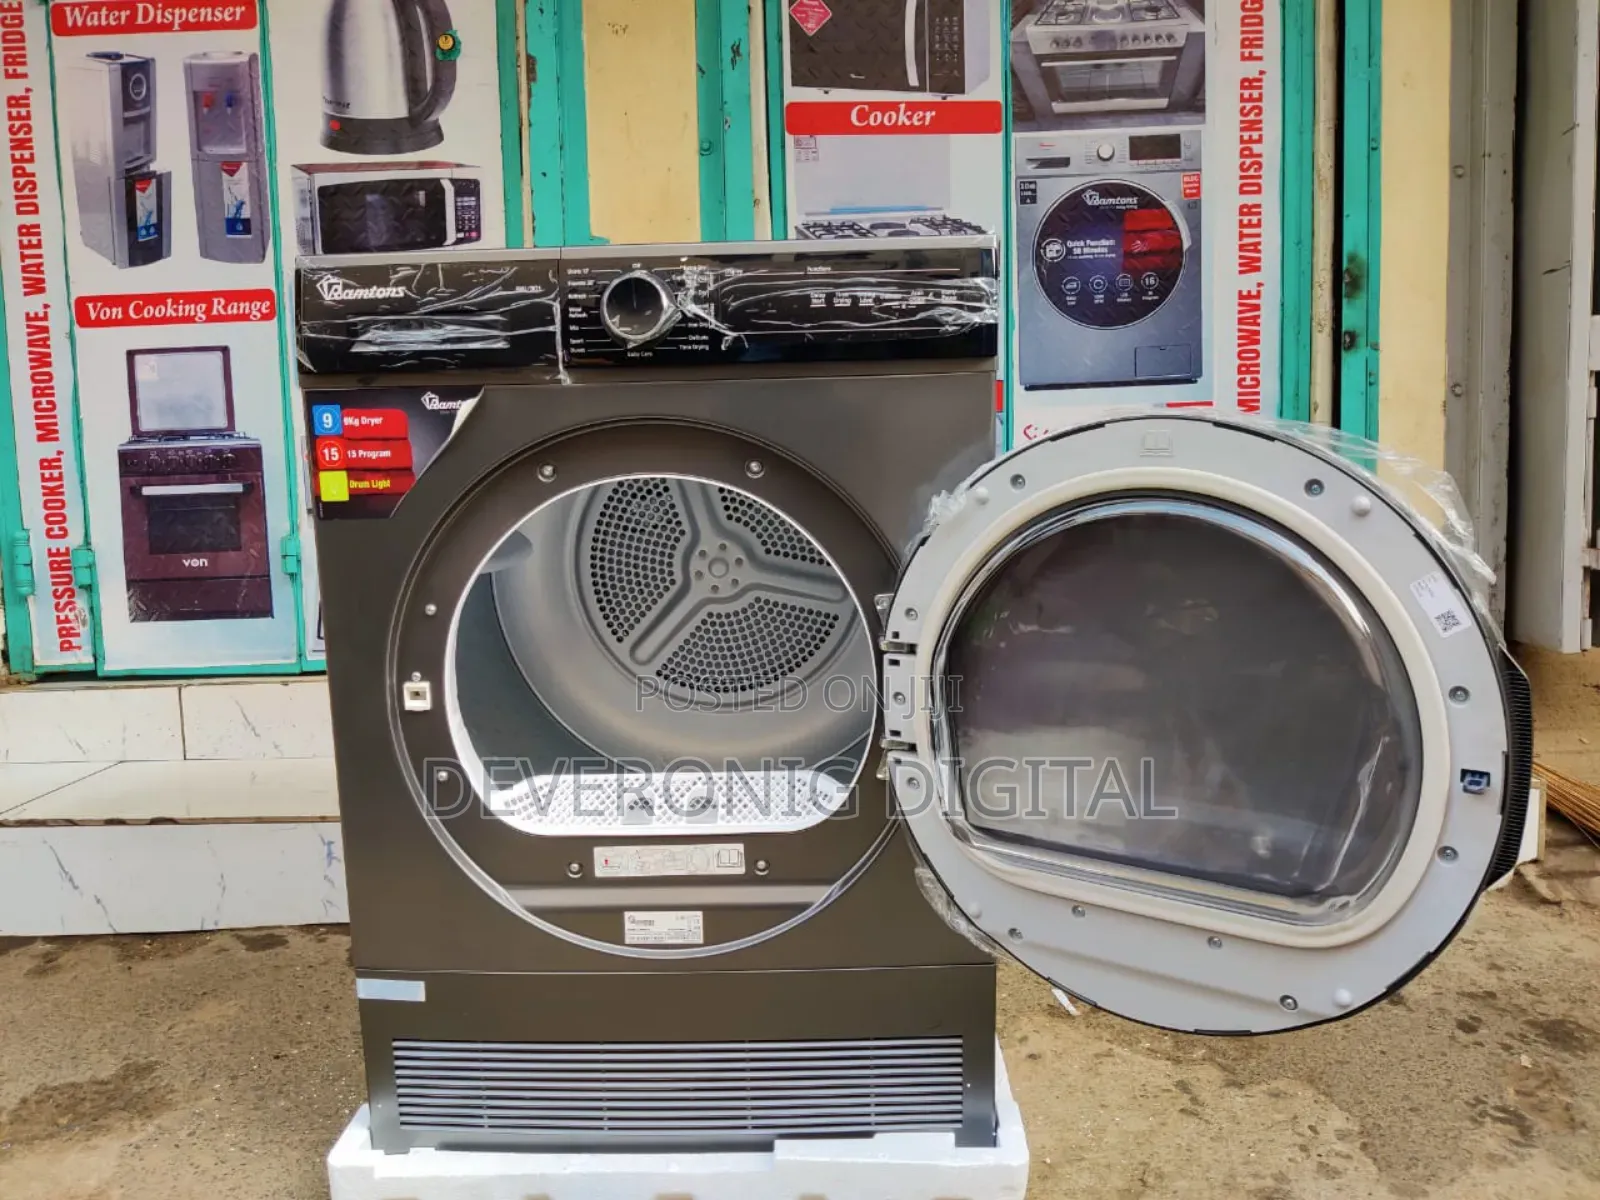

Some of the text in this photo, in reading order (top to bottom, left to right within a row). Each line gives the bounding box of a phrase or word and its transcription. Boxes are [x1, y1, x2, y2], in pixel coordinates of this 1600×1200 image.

[64, 3, 246, 31] Water Dispenser
[850, 103, 936, 127] Cooker
[1239, 69, 1267, 196] DISPENSER,
[7, 86, 40, 216] DISPENSER,
[17, 224, 46, 297] WATER
[1238, 203, 1262, 275] WATER
[86, 296, 271, 323] Von Cooking Range
[25, 302, 60, 443] MICROWAVE,
[1237, 281, 1264, 414] MICROWAVE,
[322, 413, 333, 429] 9
[361, 416, 383, 427] Dryer
[322, 448, 340, 461] 15
[347, 449, 391, 460] 15 Program
[36, 450, 68, 540] COOKER,
[349, 479, 391, 490] Drum Light
[47, 547, 81, 652] PRESSURE
